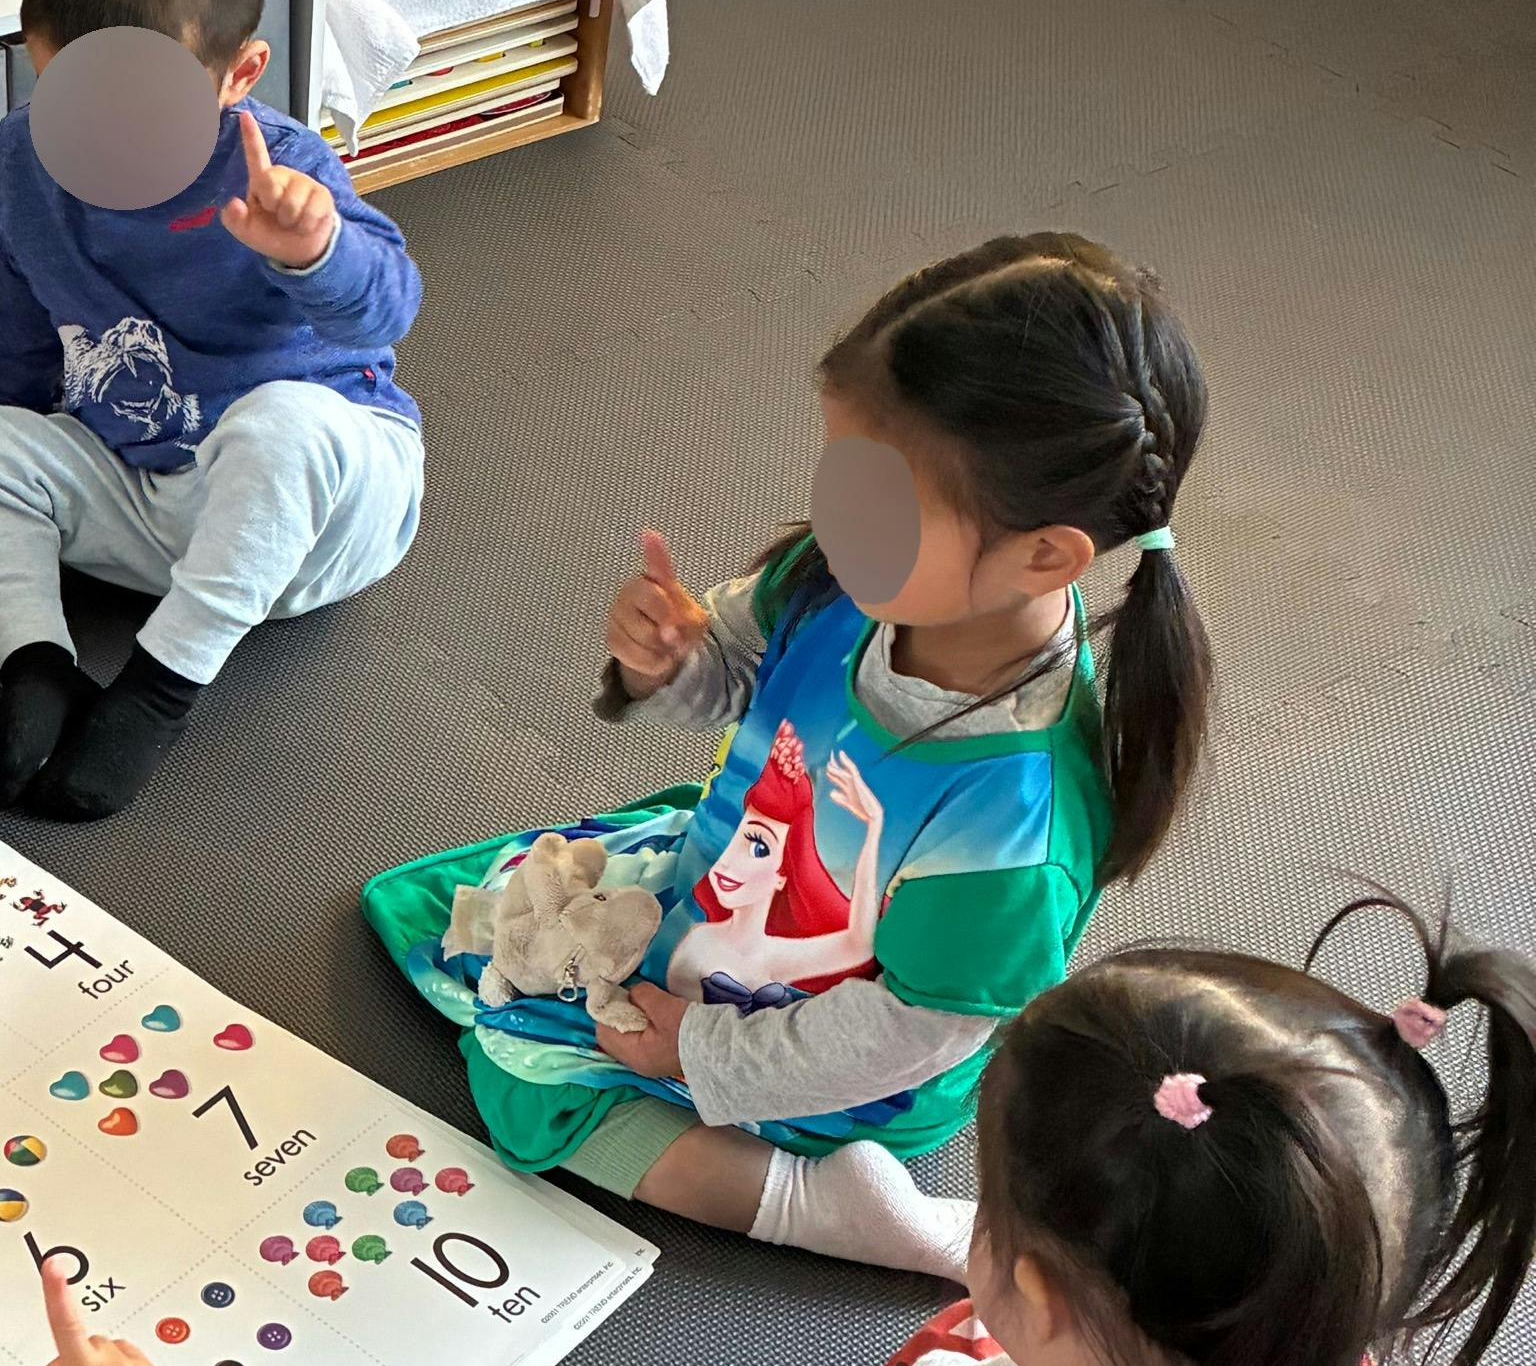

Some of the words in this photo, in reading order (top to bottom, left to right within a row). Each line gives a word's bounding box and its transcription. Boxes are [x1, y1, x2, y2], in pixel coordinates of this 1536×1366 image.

[24, 929, 109, 972] 4
[78, 957, 137, 1002] four
[191, 1085, 260, 1152] 7
[242, 1128, 318, 1188] seven
[410, 1230, 511, 1312] 10
[80, 1275, 128, 1315] six
[487, 1282, 542, 1326] ten
[556, 1292, 578, 1310] TREND
[588, 1297, 608, 1316] TREND
